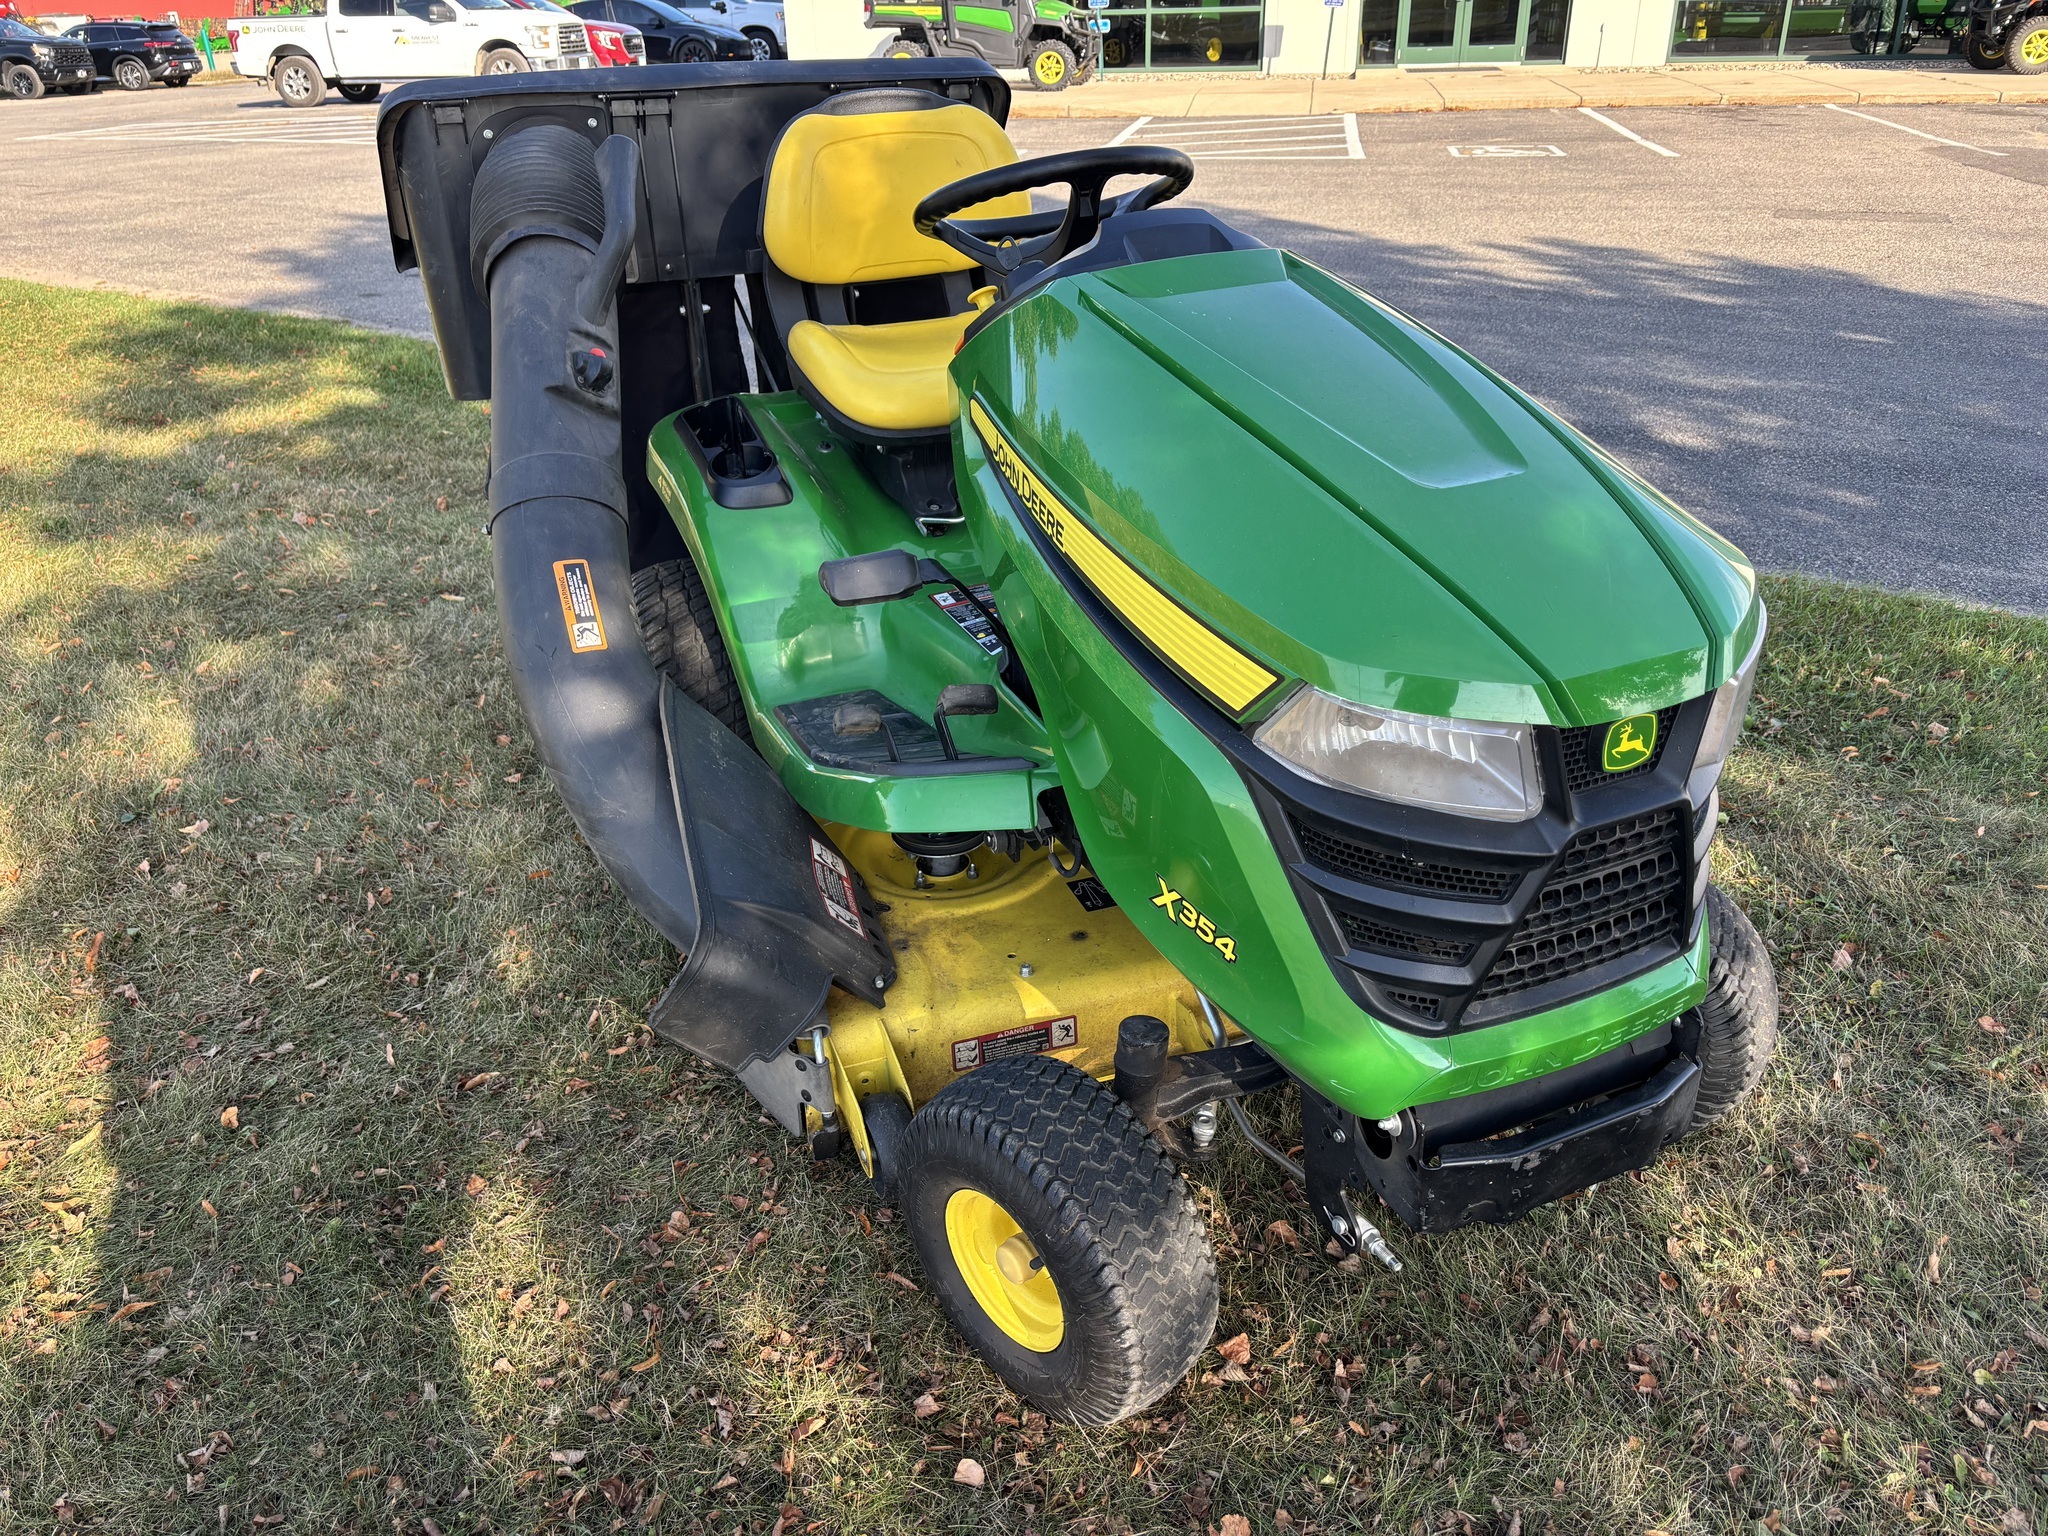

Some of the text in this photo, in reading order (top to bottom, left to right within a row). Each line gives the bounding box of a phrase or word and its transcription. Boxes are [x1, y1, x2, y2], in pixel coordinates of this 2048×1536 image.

[253, 24, 306, 33] JOHN DEERE
[993, 433, 1066, 549] JOHN DEERE
[558, 576, 570, 606] WARNING
[566, 571, 575, 594] OBJECTS
[1148, 871, 1239, 964] X354
[1003, 1024, 1034, 1036] DANGER
[1449, 995, 1690, 1095] JOHN DEERE
